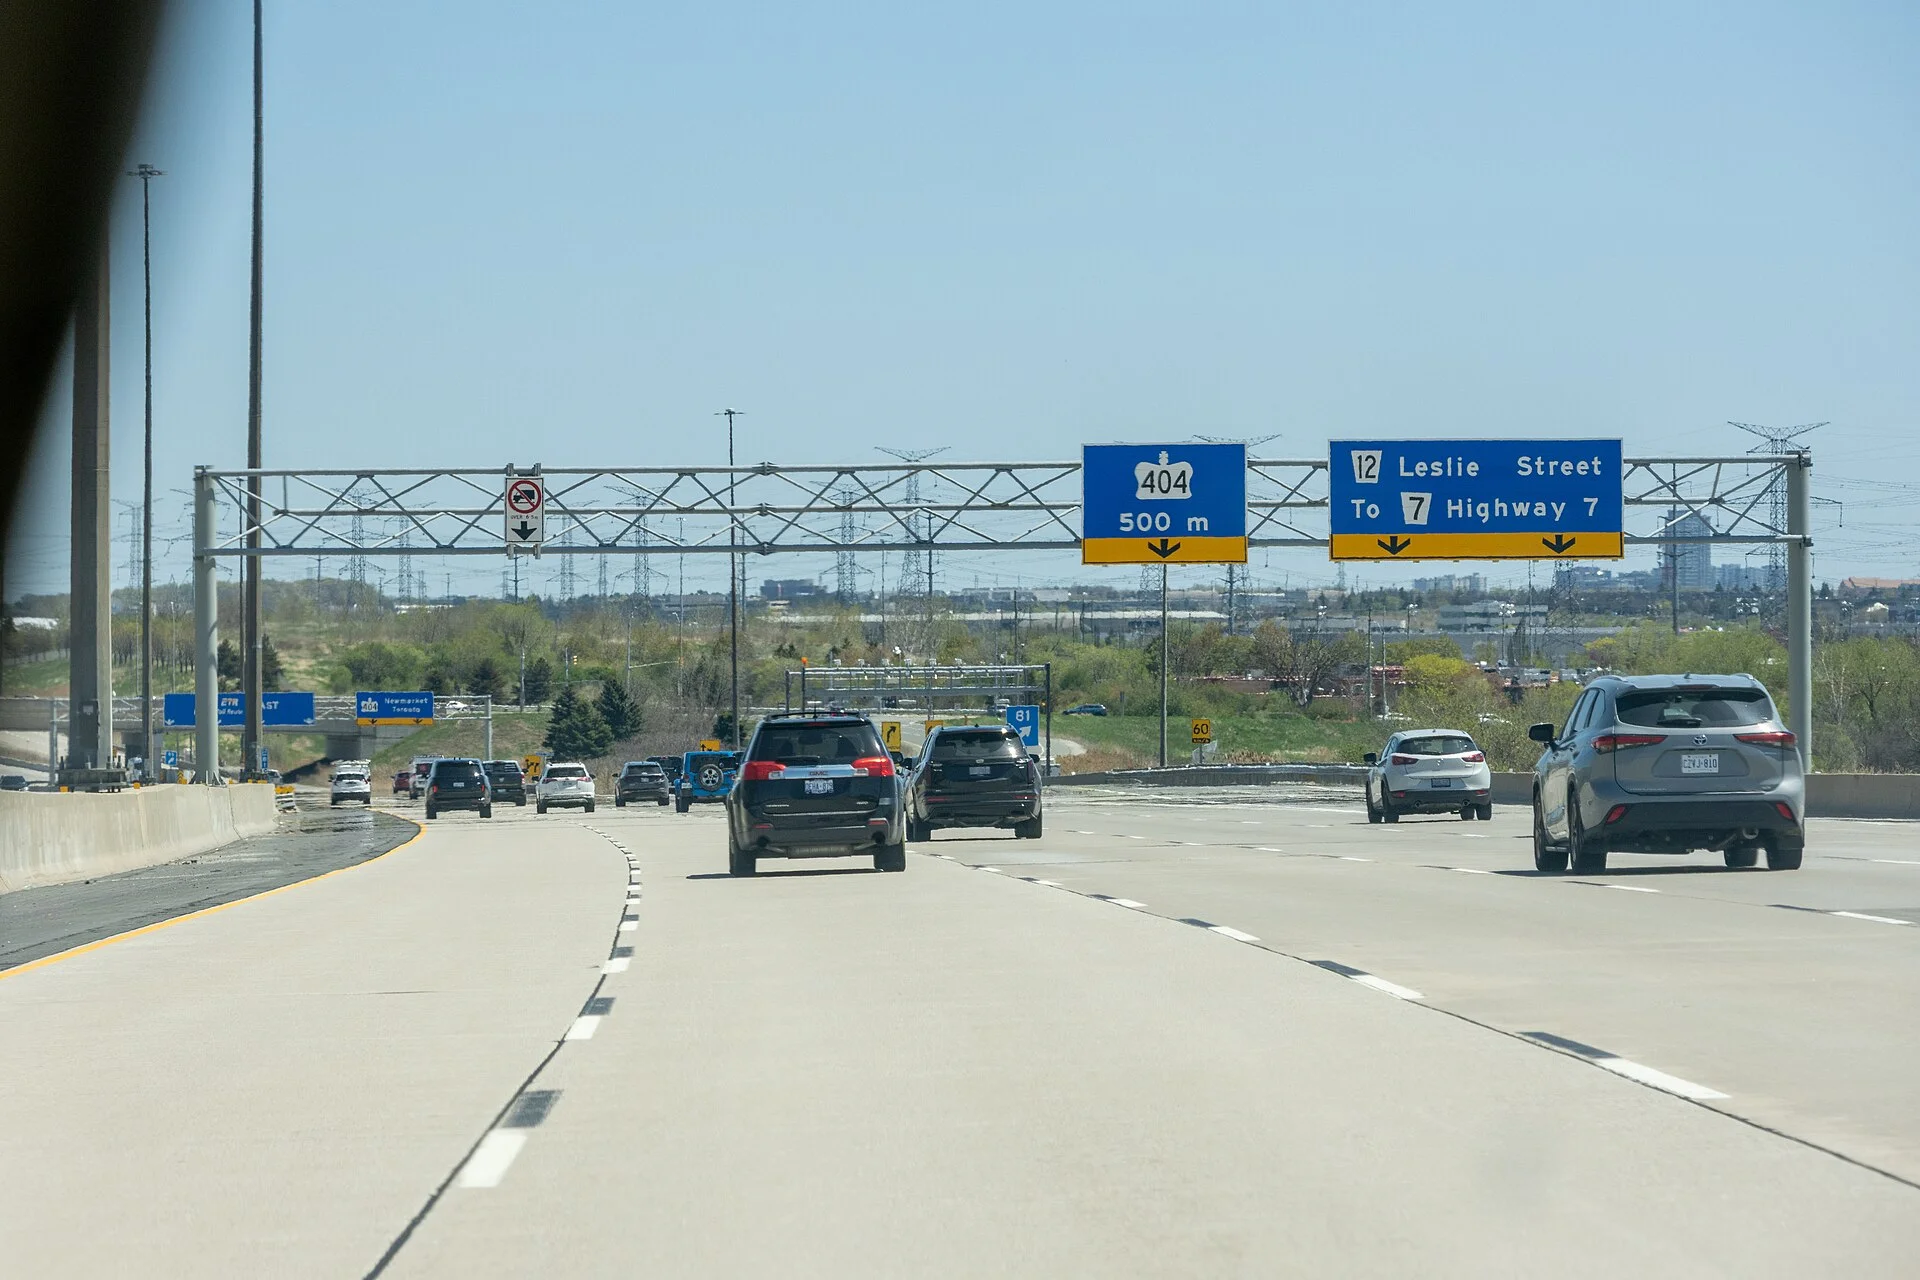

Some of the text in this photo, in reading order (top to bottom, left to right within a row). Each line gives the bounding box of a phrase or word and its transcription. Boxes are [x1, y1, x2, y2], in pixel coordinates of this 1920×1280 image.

[1356, 455, 1602, 479] 12 Leslie Street
[1141, 470, 1188, 494] 404
[1351, 496, 1599, 523] To 7 Highway 7
[1119, 512, 1209, 532] 500 m
[220, 697, 279, 710] ETR AST
[362, 703, 377, 712] 404
[1015, 709, 1031, 722] 81
[1193, 723, 1208, 734] 60
